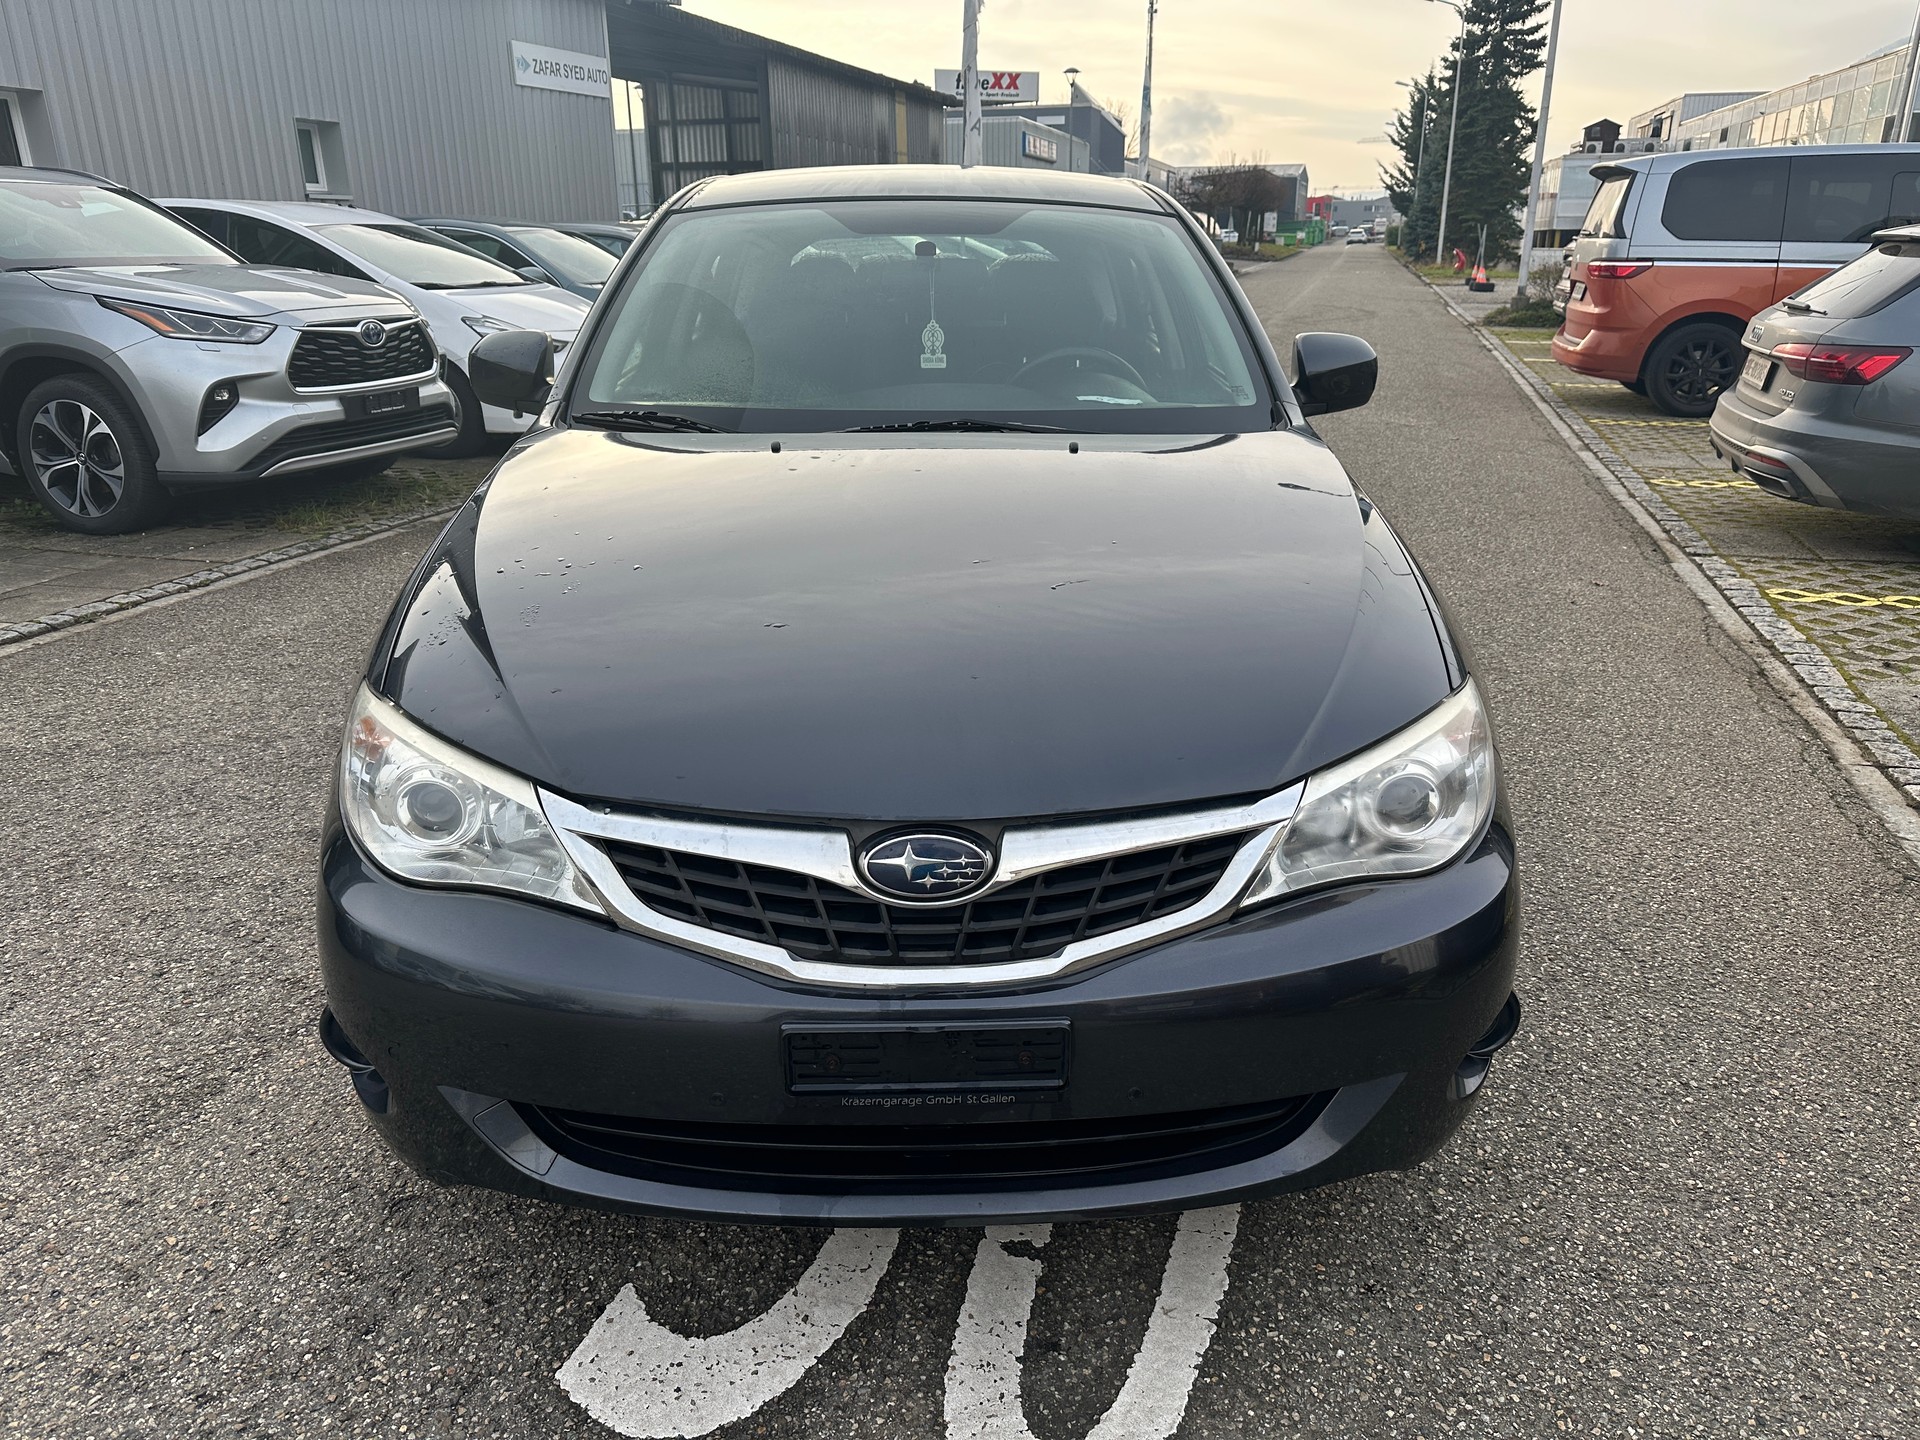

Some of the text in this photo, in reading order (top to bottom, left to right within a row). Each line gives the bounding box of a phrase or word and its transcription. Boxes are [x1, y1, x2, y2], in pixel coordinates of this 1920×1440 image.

[532, 58, 562, 78] ZAFAR
[563, 63, 585, 81] SYED
[587, 67, 608, 85] AUTO
[926, 1095, 962, 1105] GmbH
